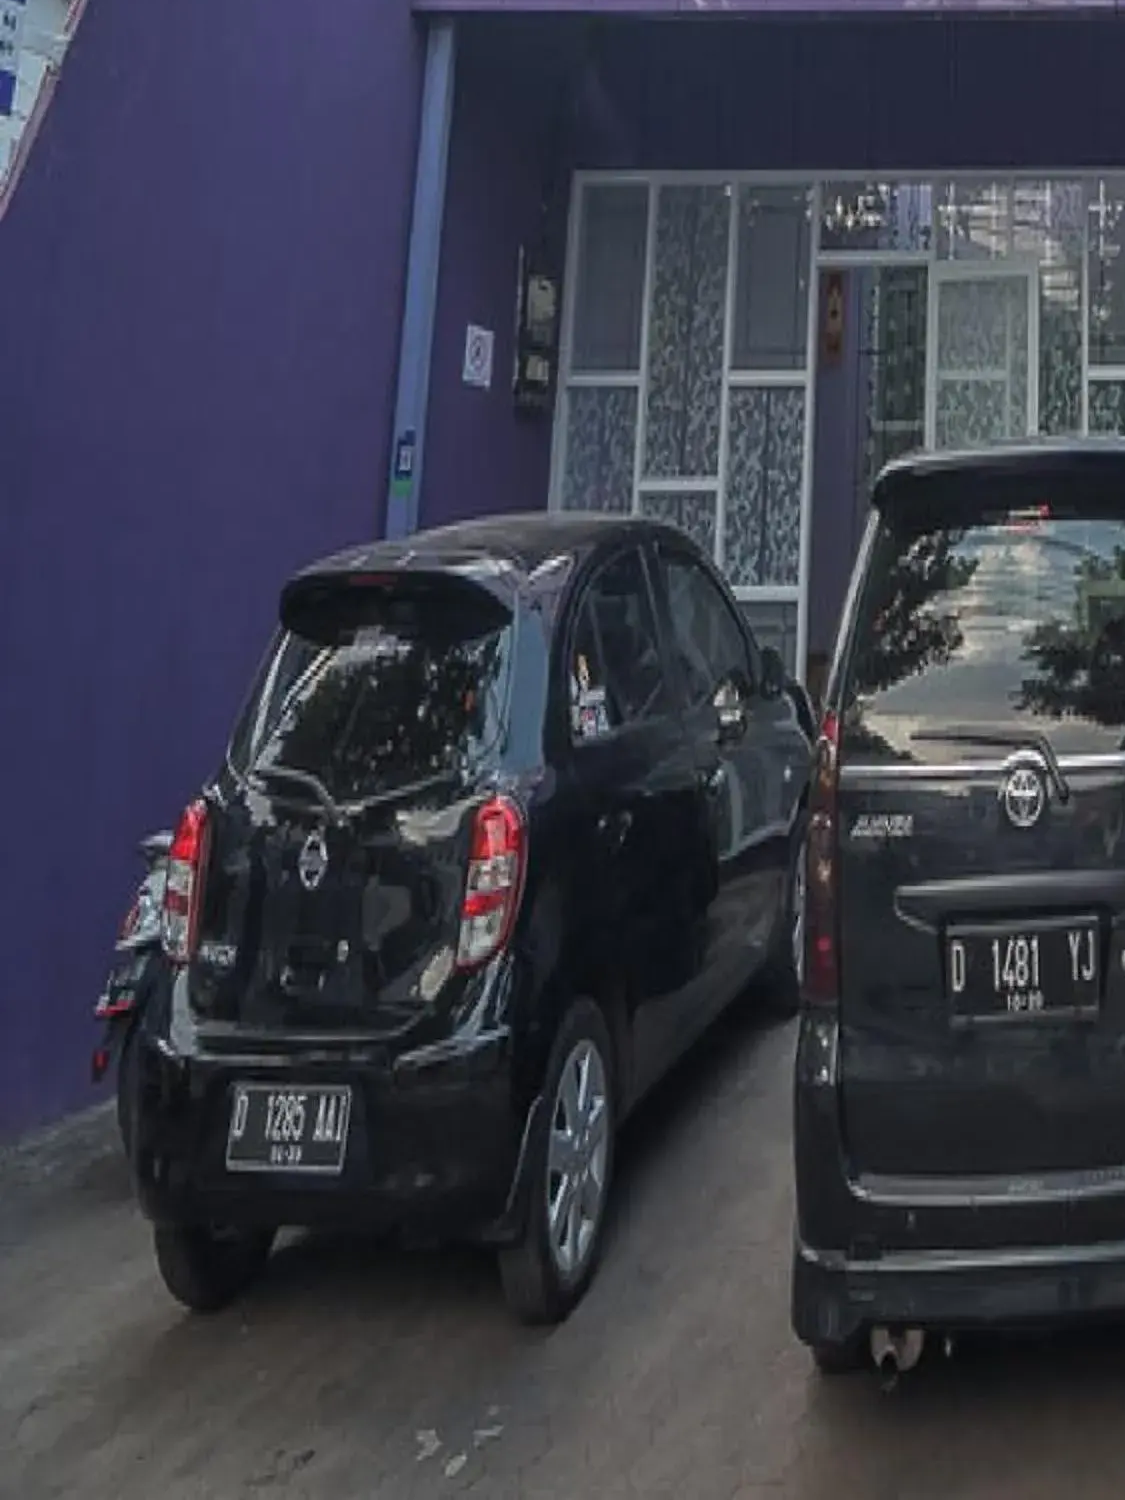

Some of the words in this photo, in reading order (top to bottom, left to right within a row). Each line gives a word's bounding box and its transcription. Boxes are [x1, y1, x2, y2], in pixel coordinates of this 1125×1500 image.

[952, 940, 966, 992] D
[992, 934, 1039, 992] 1481
[1068, 929, 1096, 981] YJ
[233, 1095, 249, 1137] D
